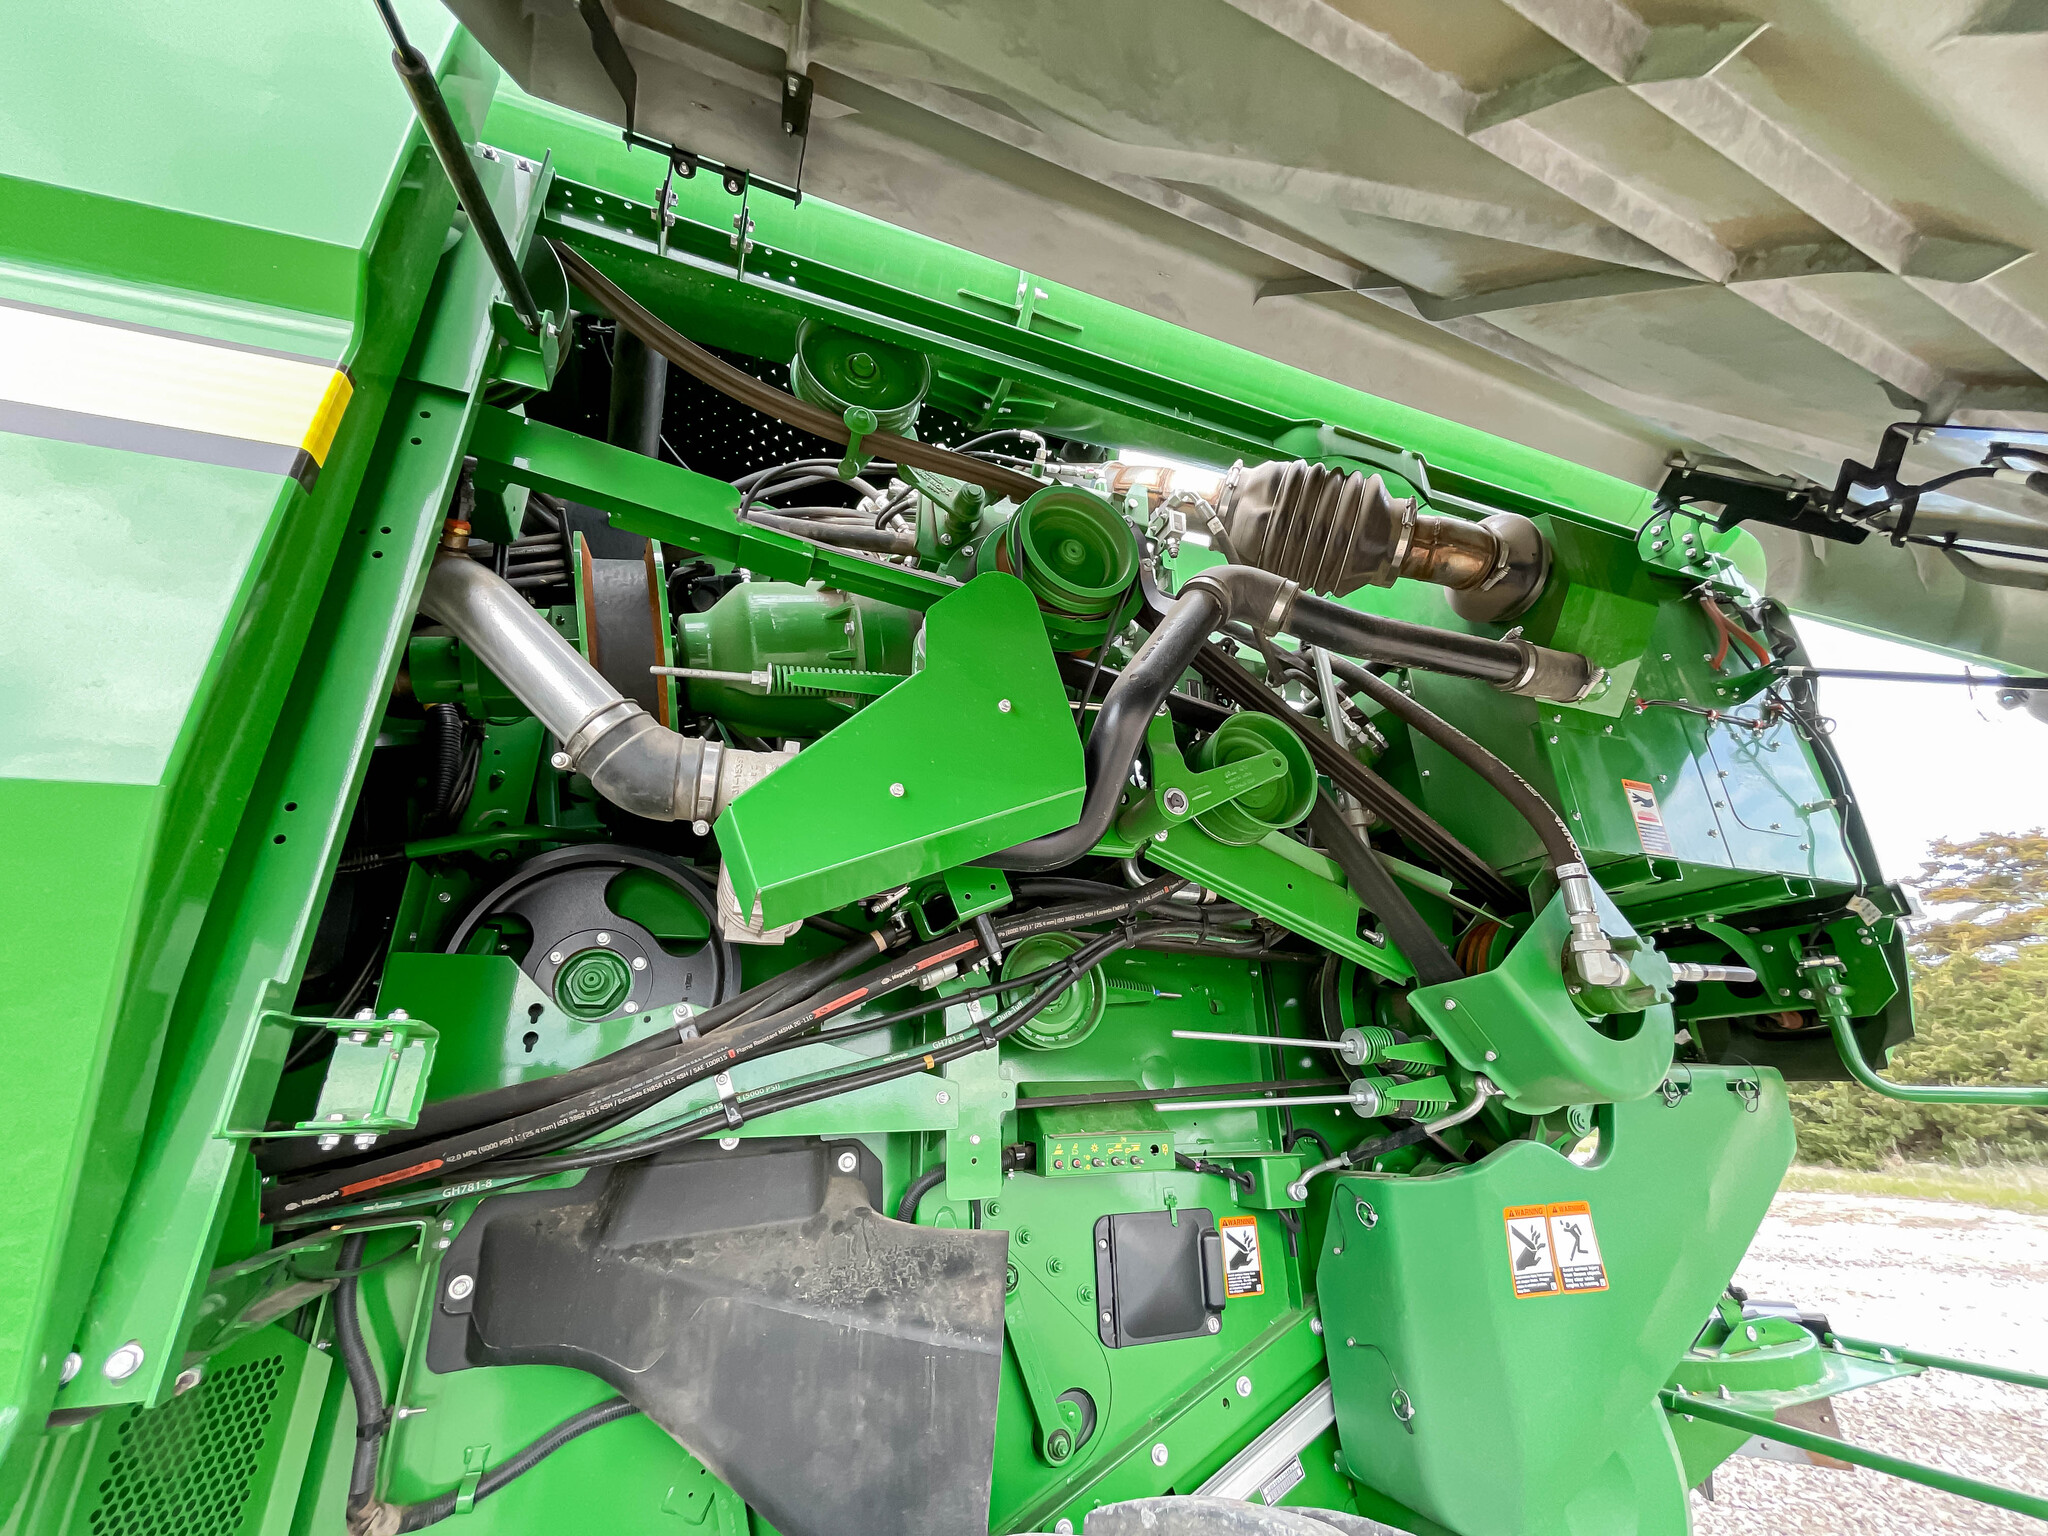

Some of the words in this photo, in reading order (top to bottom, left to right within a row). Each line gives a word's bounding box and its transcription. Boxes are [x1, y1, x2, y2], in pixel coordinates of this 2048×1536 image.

[996, 1000, 1025, 1022] Dura-Tuff
[932, 1034, 965, 1050] GH781-8
[462, 1148, 477, 1159] MPa
[522, 1126, 541, 1141] (25.4
[540, 1121, 558, 1134] mm)
[557, 1116, 569, 1128] ISO
[569, 1111, 586, 1123] 3862
[586, 1106, 600, 1117] R15
[617, 1091, 643, 1105] Exceeds
[642, 1082, 664, 1095] EN856
[663, 1075, 677, 1087] R15
[693, 1063, 706, 1075] SAE
[705, 1054, 729, 1068] 100R15
[736, 1043, 754, 1055] Flame
[753, 1031, 778, 1047] Resistant
[778, 1023, 794, 1037] MSHA
[793, 1014, 814, 1028] 2G-11C
[742, 1088, 765, 1102] (5000
[765, 1083, 781, 1095] PSI)
[708, 1102, 724, 1113] 345
[442, 1178, 493, 1199] GH781-8
[1515, 1207, 1544, 1217] WARNING
[1558, 1204, 1586, 1213] WARNING
[1228, 1217, 1255, 1227] WARNING
